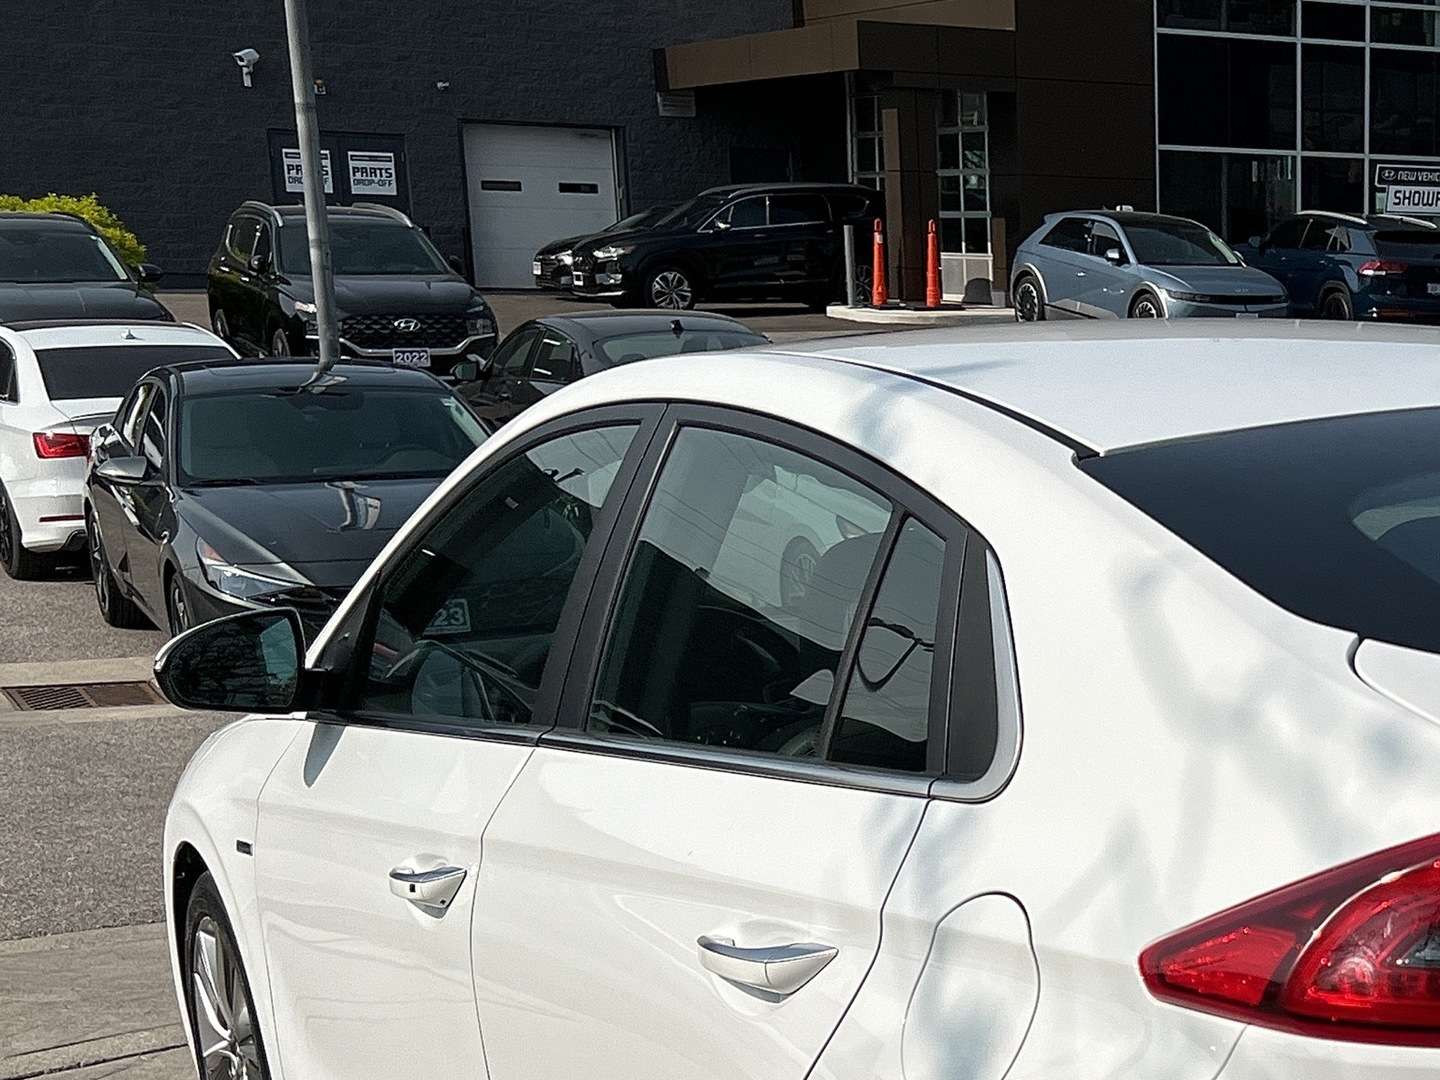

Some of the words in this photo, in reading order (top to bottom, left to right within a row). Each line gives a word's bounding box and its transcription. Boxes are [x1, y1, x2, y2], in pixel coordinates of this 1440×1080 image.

[352, 166, 393, 179] PARTS
[1397, 170, 1417, 181] NEW
[352, 178, 393, 188] DROP-OFF
[395, 352, 428, 364] 2022
